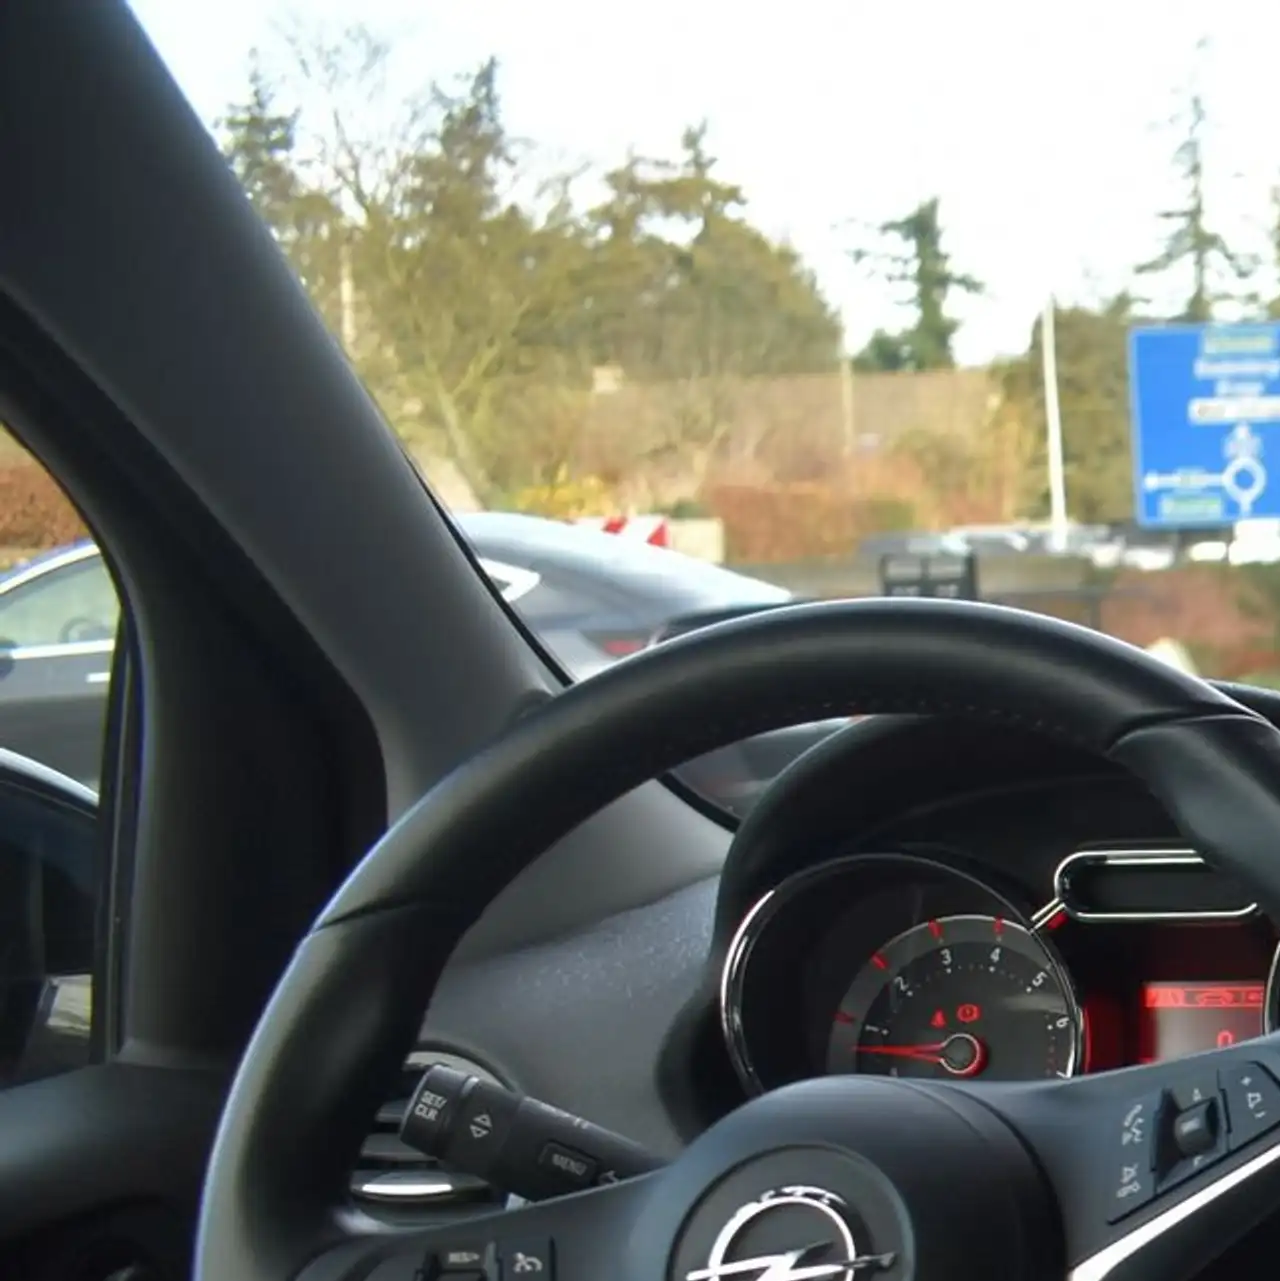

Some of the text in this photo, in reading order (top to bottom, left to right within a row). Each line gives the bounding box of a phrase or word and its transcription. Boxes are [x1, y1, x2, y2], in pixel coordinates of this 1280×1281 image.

[940, 949, 952, 965] 3
[990, 947, 1001, 963] 4
[894, 976, 909, 992] 2
[1032, 971, 1048, 988] 5
[1056, 1016, 1070, 1029] 6
